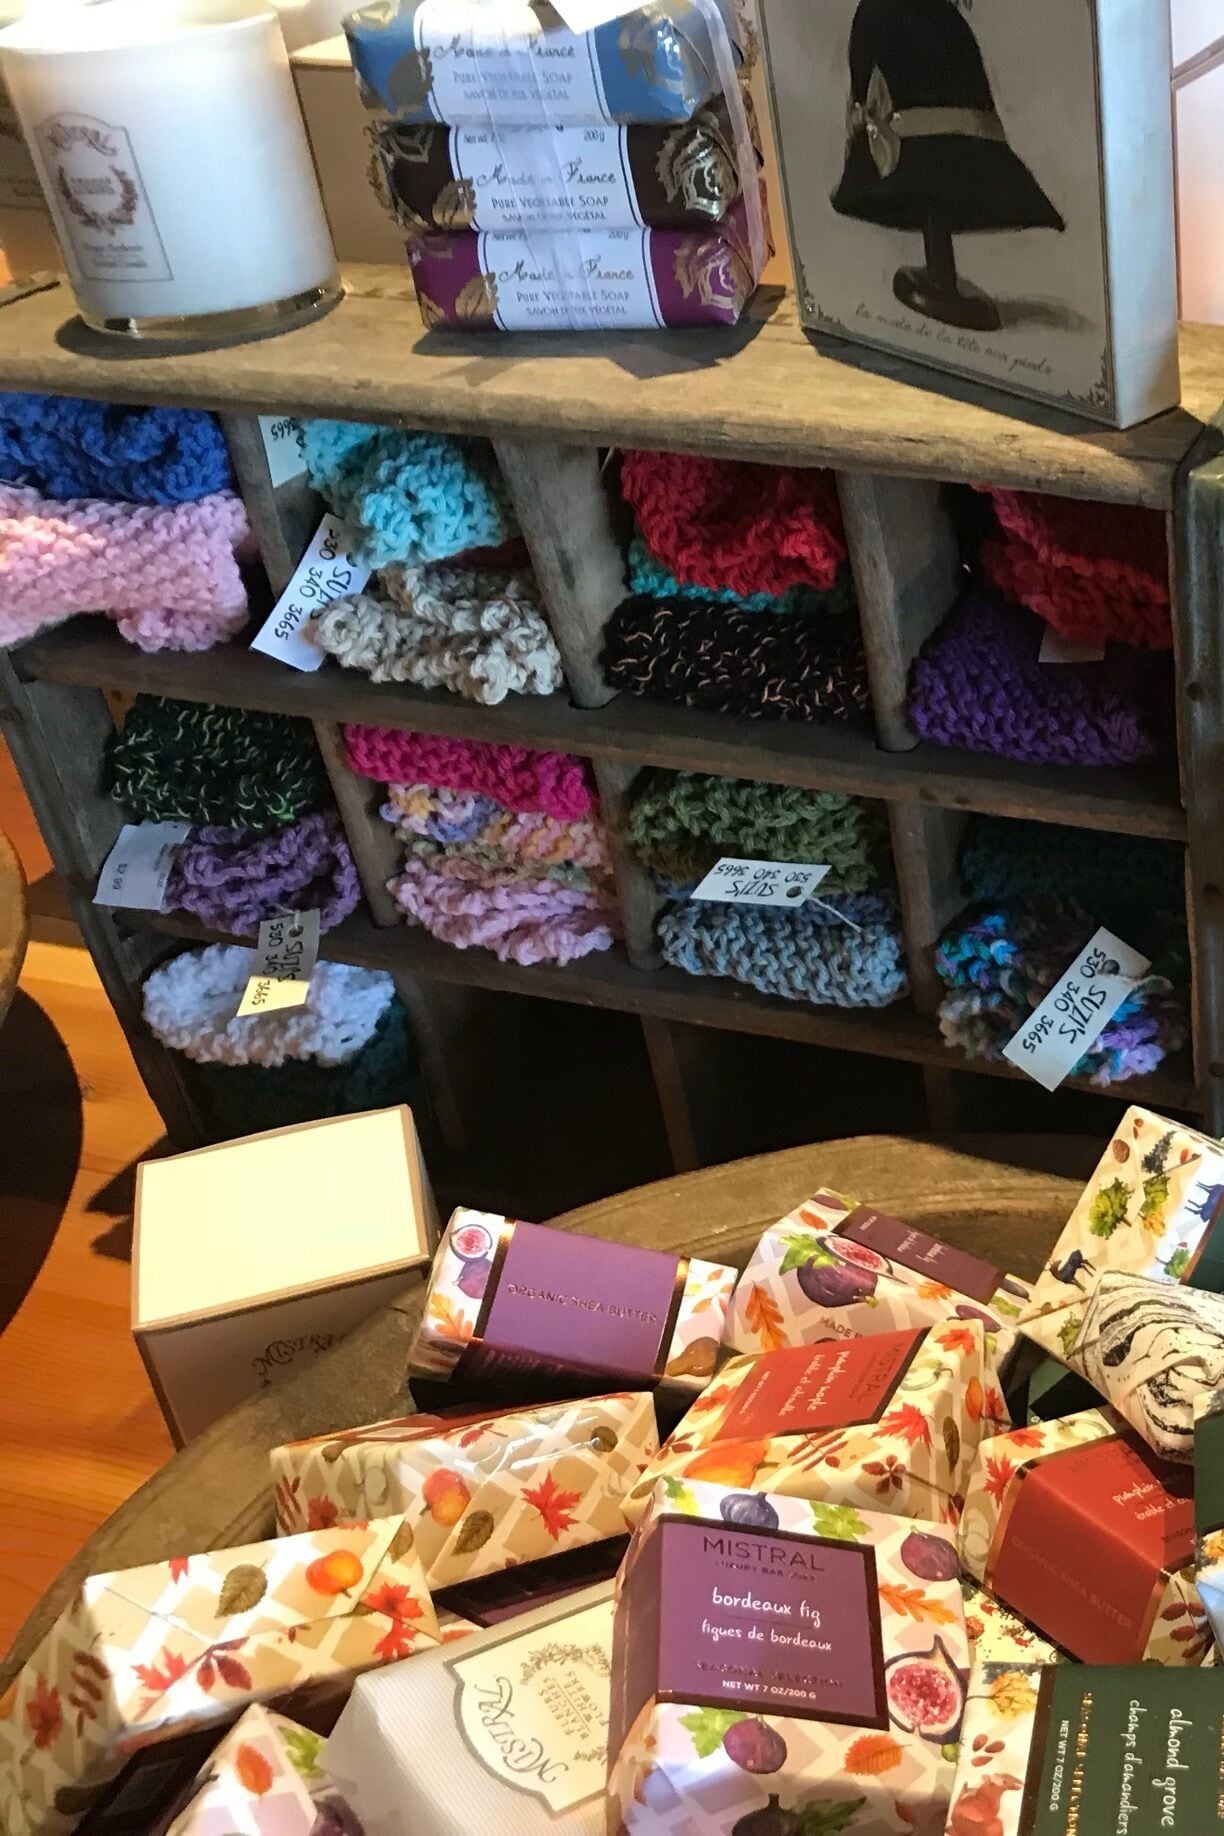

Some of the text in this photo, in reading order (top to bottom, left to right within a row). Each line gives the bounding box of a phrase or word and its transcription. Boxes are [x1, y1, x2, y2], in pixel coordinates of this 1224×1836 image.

[578, 195, 609, 208] SOAP
[600, 288, 631, 302] SOAP
[299, 567, 323, 599] 340
[274, 603, 303, 641] 3665
[713, 862, 812, 884] 530 340 3665
[268, 922, 284, 948] 530
[251, 979, 271, 1006] 3665
[1022, 947, 1107, 1054] 530 340 3665
[1058, 985, 1107, 1045] SUZI'S
[506, 1283, 658, 1324] ORGANIC SHEA BUTTER
[819, 1315, 853, 1338] MADE
[702, 1534, 827, 1573] MISTRAL
[711, 1586, 822, 1628] bordeaux fig
[701, 1617, 833, 1652] figues de bordeaux
[696, 1659, 765, 1679] SEASONAL
[563, 1681, 593, 1722] WHITE
[565, 1670, 609, 1726] FLOWERS
[722, 1678, 741, 1690] NET
[743, 1681, 761, 1692] WT
[770, 1685, 808, 1700] OZ/200
[808, 1690, 817, 1700] G
[538, 1689, 575, 1736] FLEURS
[543, 1677, 590, 1740] BLANCHES
[1119, 1699, 1148, 1748] champs
[473, 1676, 570, 1783] MISTRAL
[1057, 1739, 1067, 1755] WT
[1059, 1719, 1070, 1738] NET
[1051, 1764, 1064, 1801] OZ/200
[1151, 1708, 1193, 1827] almond grove
[1049, 1802, 1059, 1811] G
